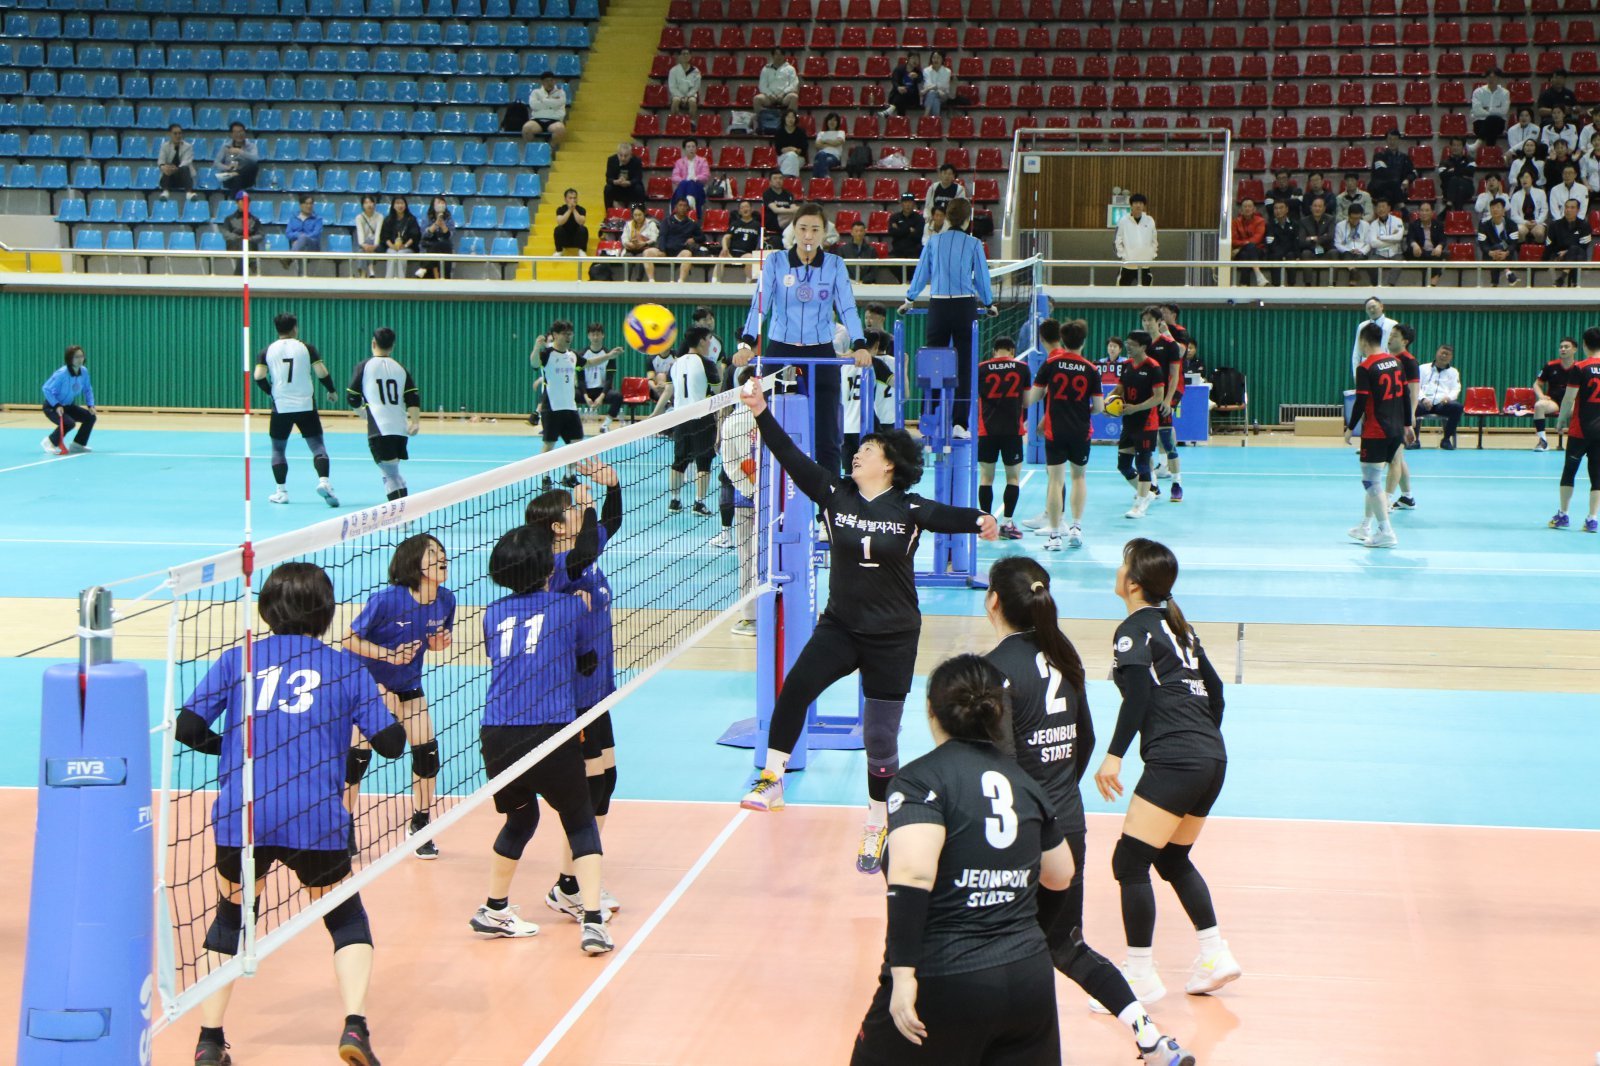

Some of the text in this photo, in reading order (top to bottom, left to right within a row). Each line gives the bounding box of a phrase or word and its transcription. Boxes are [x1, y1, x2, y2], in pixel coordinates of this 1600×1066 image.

[282, 358, 294, 383] 7
[988, 362, 1016, 371] ULSAN
[1058, 361, 1086, 372] ULSAN
[1377, 360, 1398, 371] ULSAN
[376, 378, 399, 405] 10
[683, 373, 689, 398] 1
[985, 371, 1021, 399] 22
[1052, 372, 1088, 401] 29
[1378, 370, 1404, 401] 25
[860, 536, 872, 560] 1
[496, 613, 546, 658] 11
[256, 665, 322, 714] 13
[1035, 651, 1067, 716] 2
[1027, 723, 1077, 746] JEONBUK
[1040, 743, 1073, 763] STATE
[67, 760, 105, 775] FIVB
[138, 806, 152, 823] FI
[981, 770, 1019, 850] 3
[954, 868, 1031, 889] JEONBUK
